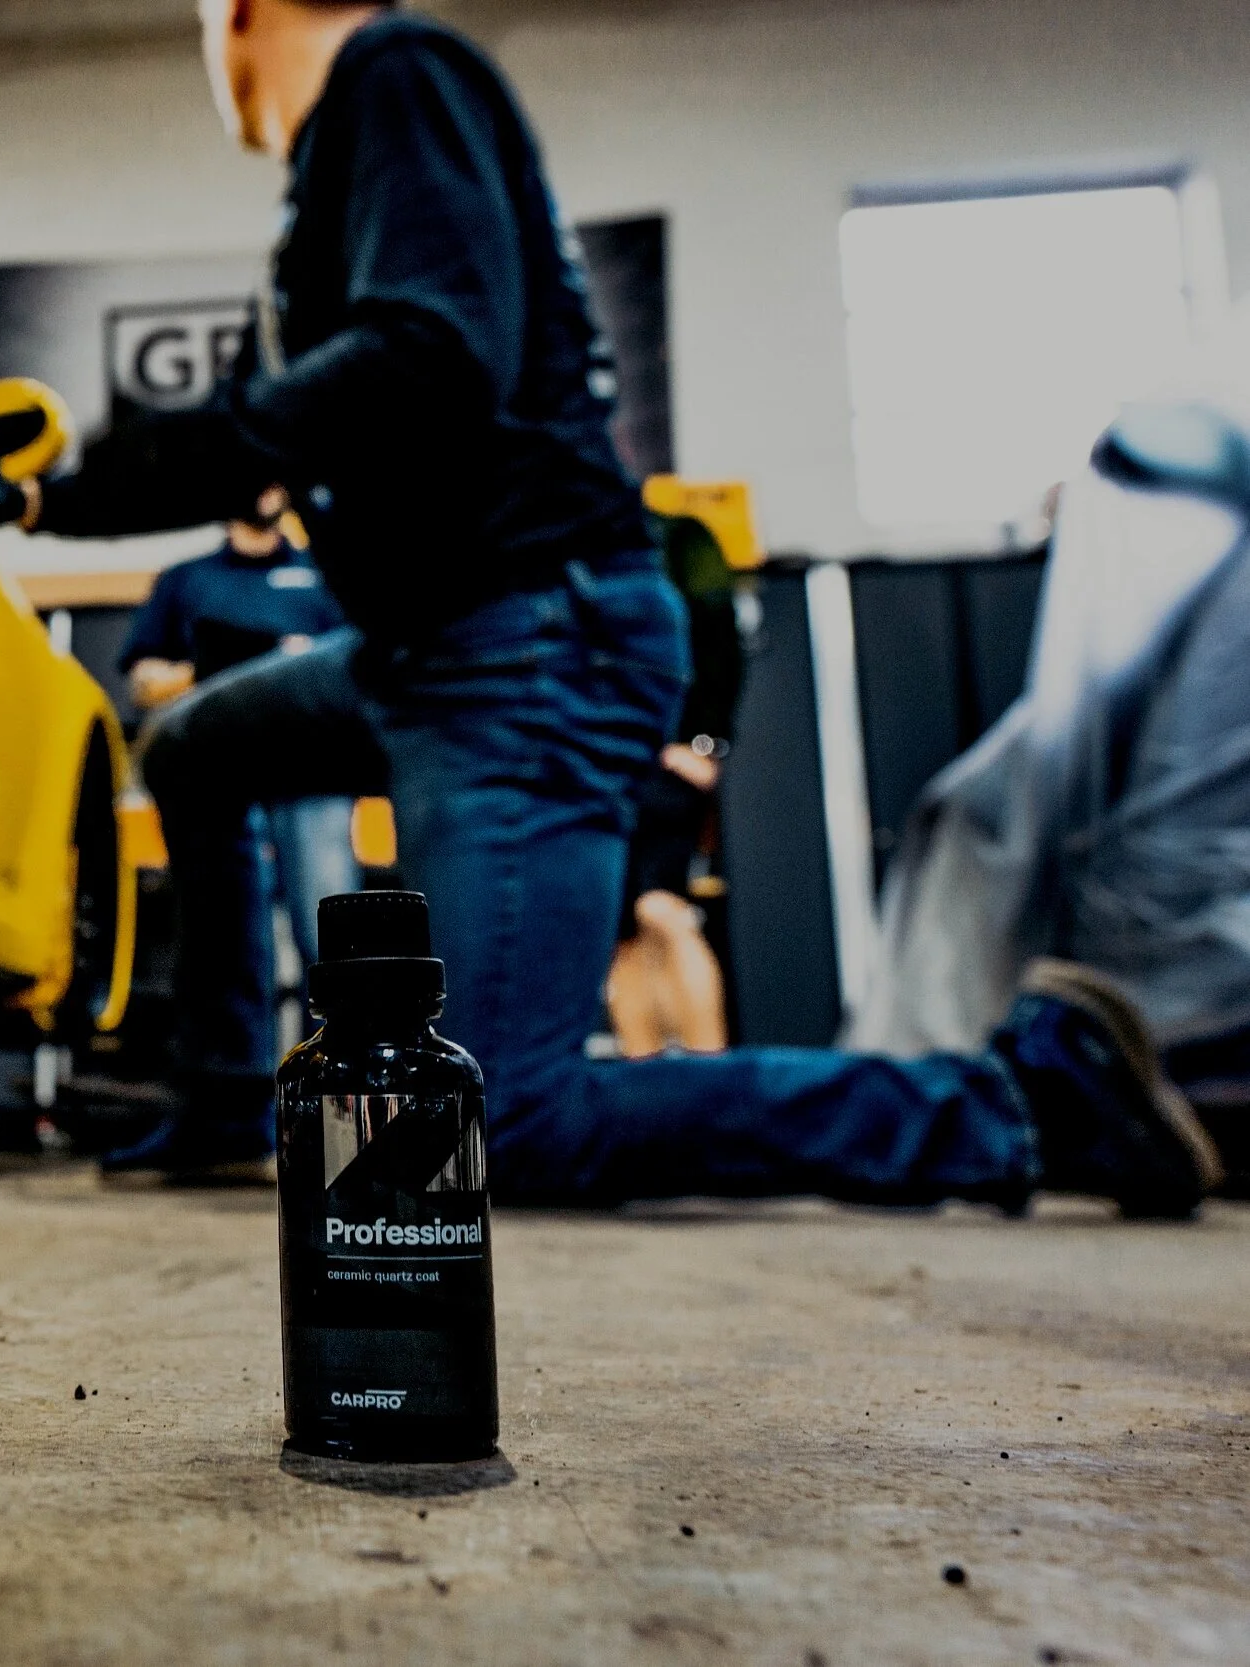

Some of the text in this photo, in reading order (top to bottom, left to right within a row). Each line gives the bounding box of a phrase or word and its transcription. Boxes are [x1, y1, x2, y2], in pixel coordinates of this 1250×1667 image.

[326, 1216, 482, 1246] Professional
[327, 1269, 441, 1284] ceramic quartz coat
[330, 1391, 402, 1410] CARPRO
